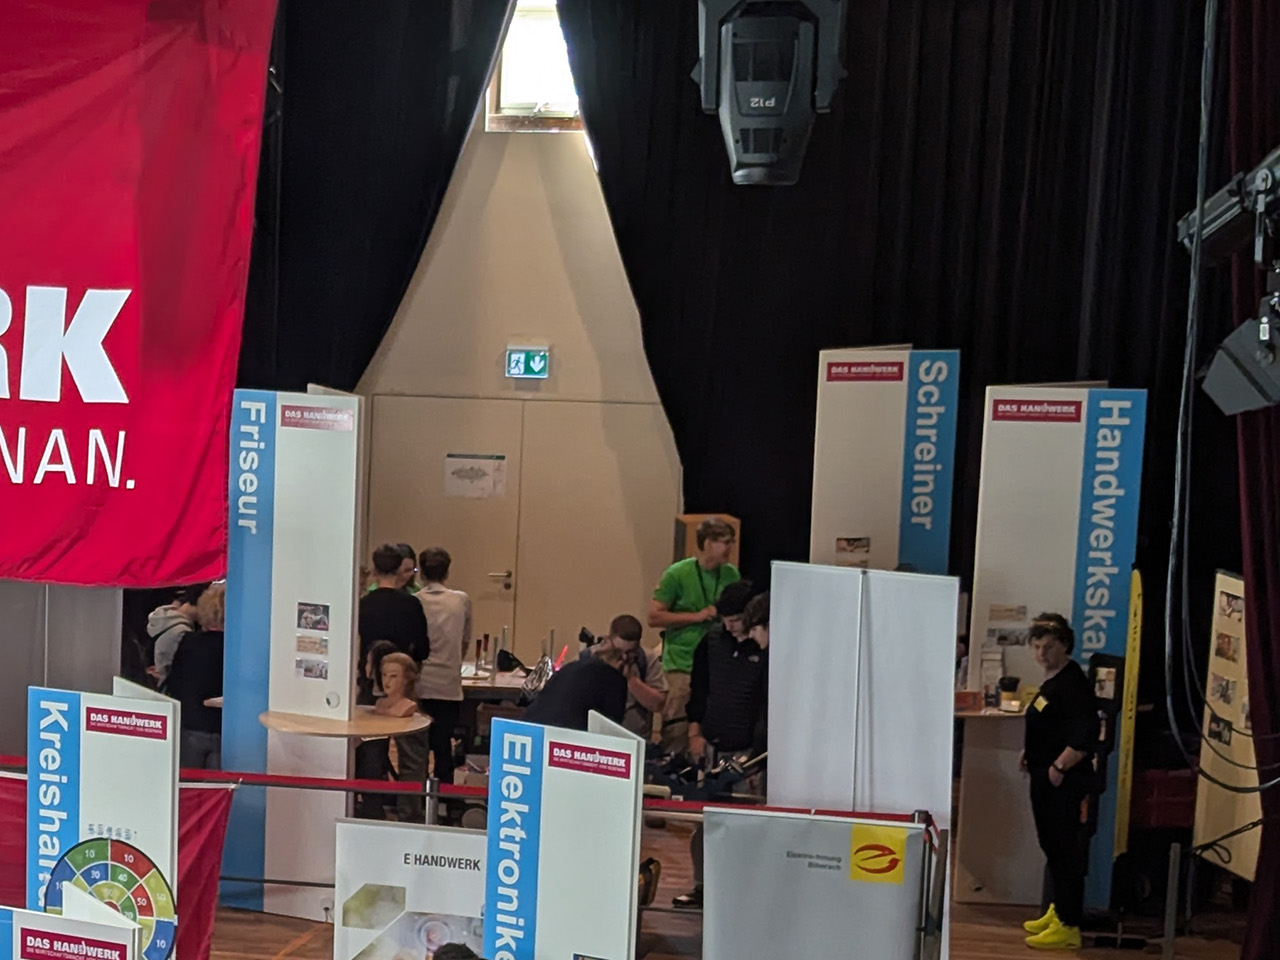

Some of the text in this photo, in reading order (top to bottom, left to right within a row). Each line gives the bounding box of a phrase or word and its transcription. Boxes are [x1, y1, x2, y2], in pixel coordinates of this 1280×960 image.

[998, 404, 1017, 412] DAS
[910, 360, 948, 530] Schreiner
[238, 401, 266, 534] Friseur
[90, 713, 108, 722] DAS
[553, 748, 571, 758] DAS
[414, 854, 481, 871] HANDWERK
[26, 936, 120, 960] DAS HANDWERK
